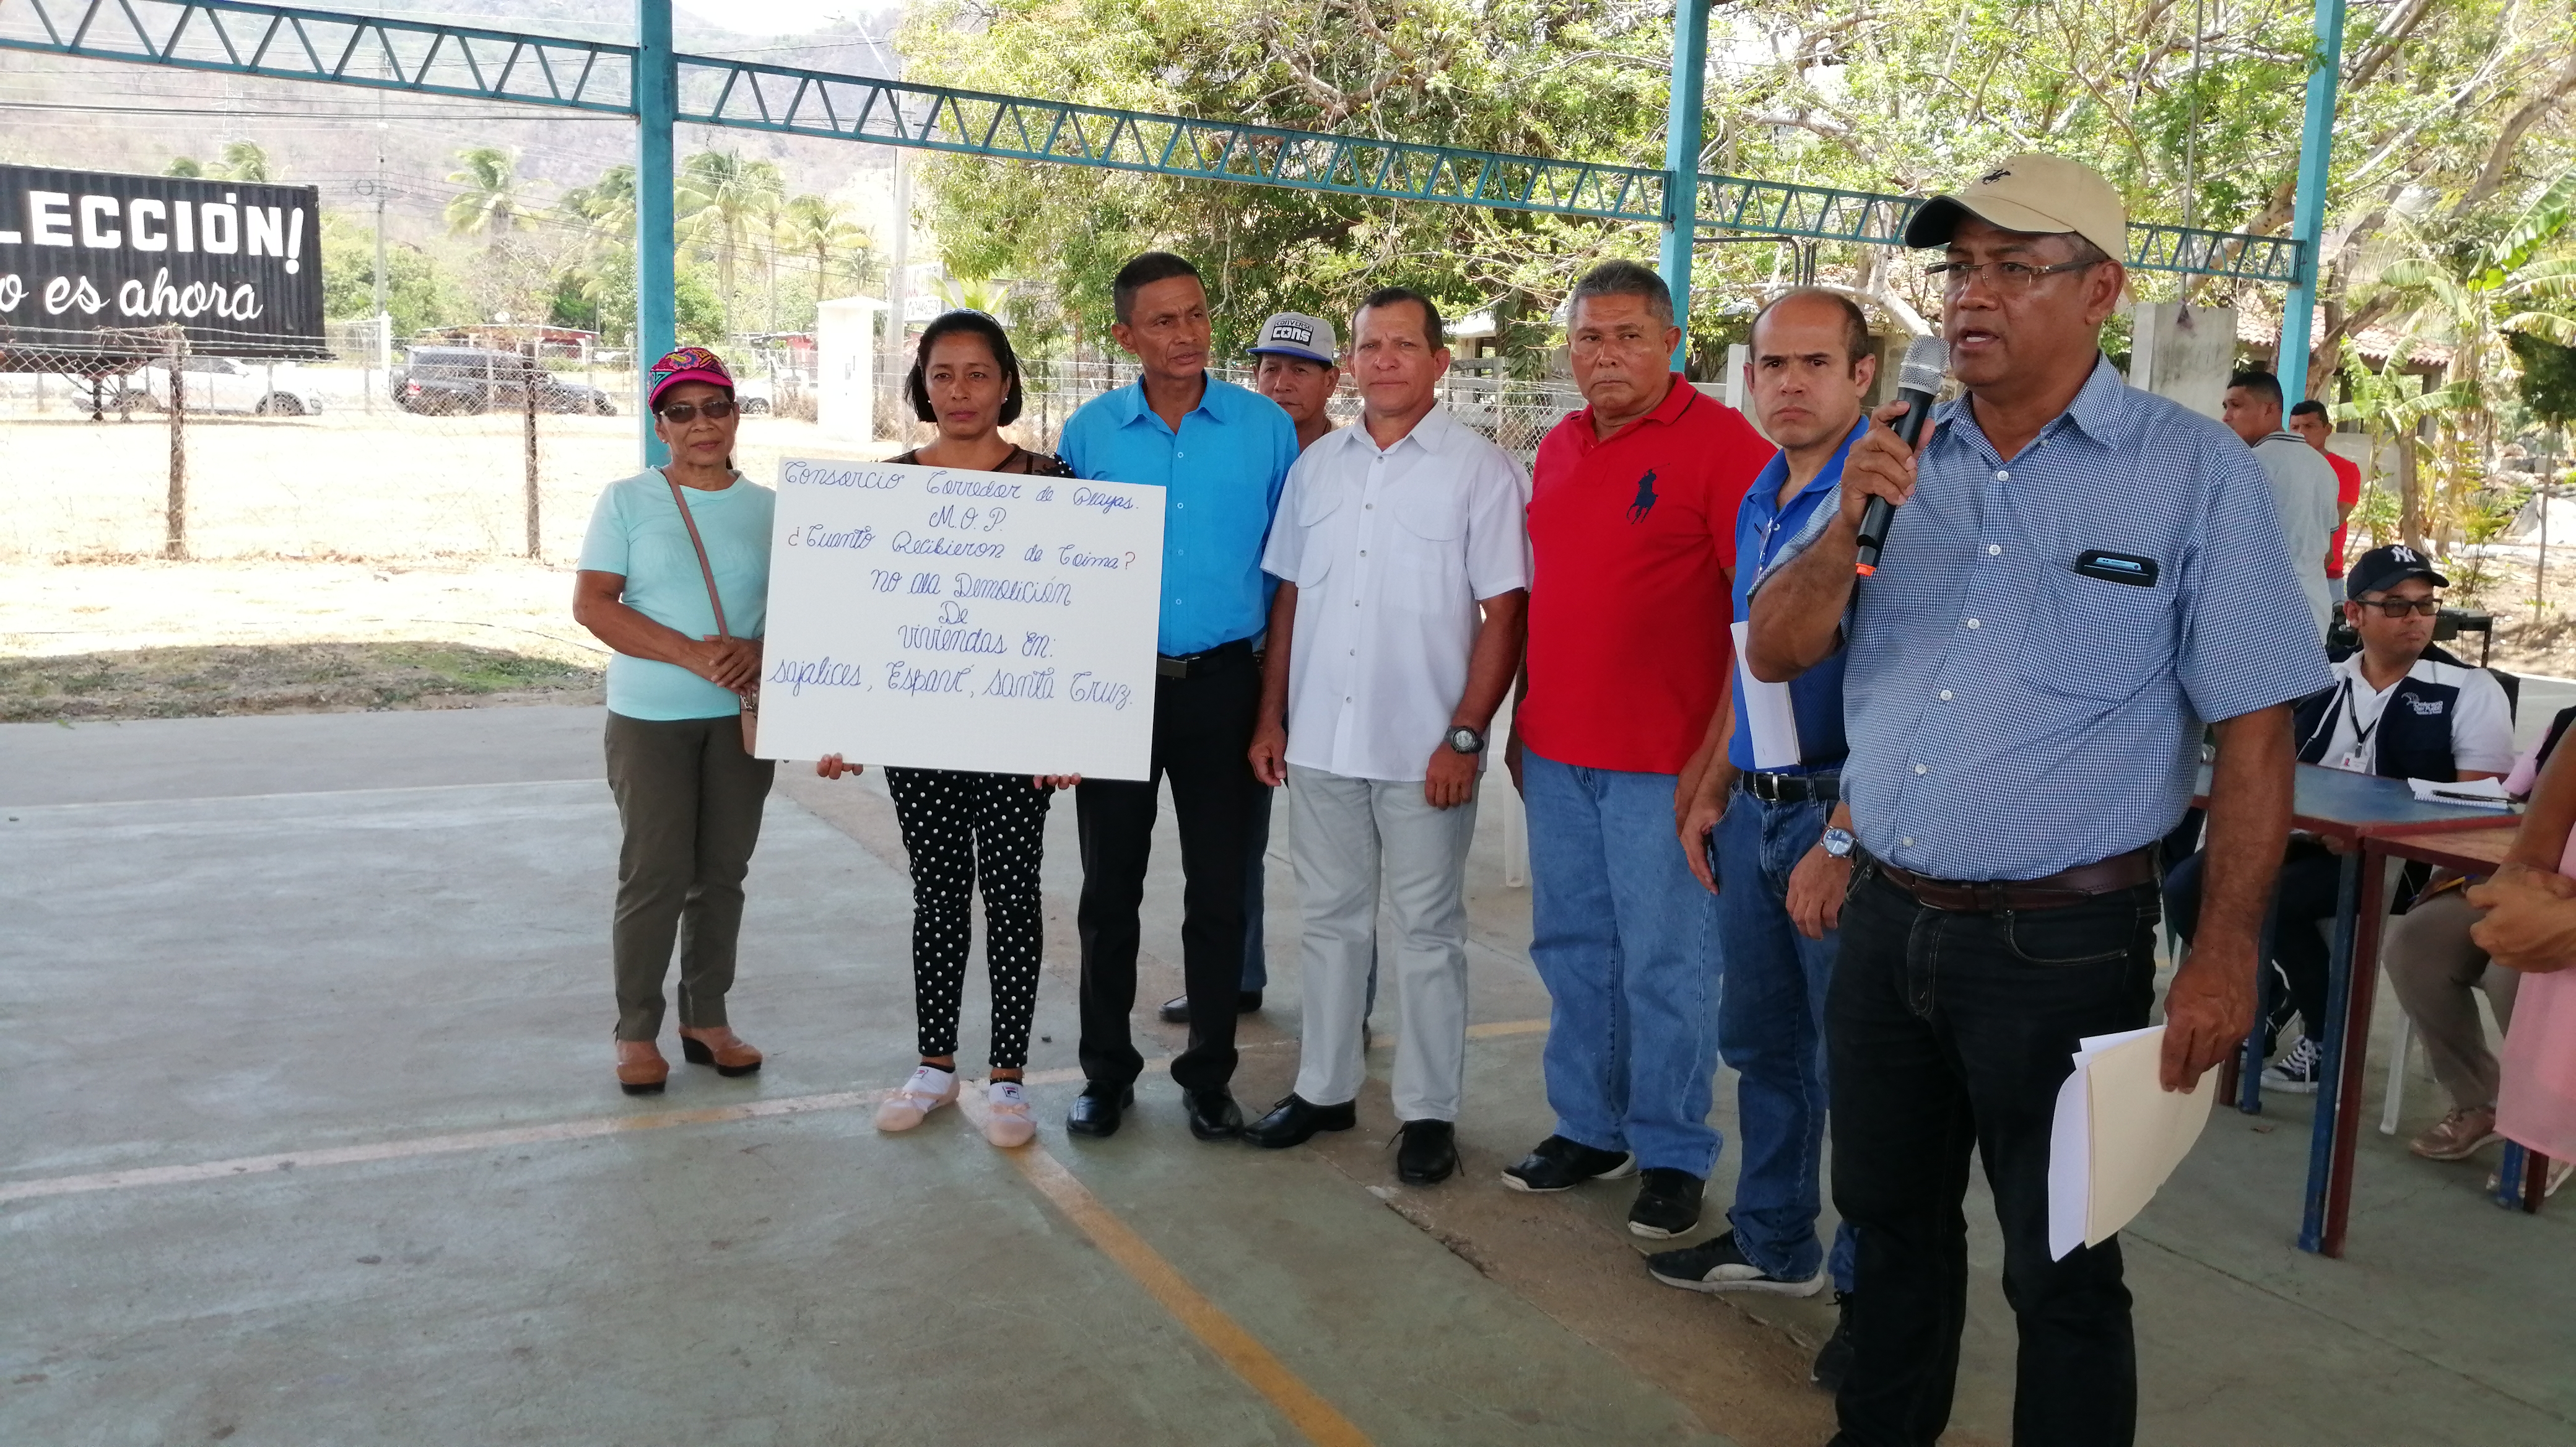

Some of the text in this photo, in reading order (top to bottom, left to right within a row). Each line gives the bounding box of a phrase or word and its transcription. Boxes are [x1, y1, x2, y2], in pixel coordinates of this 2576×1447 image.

[45, 276, 110, 315] es
[119, 267, 264, 320] ahora
[785, 461, 905, 489] Consorcio
[1036, 486, 1054, 502] de
[892, 530, 1006, 558] Recibieron
[1024, 544, 1043, 562] de
[938, 600, 968, 624] De
